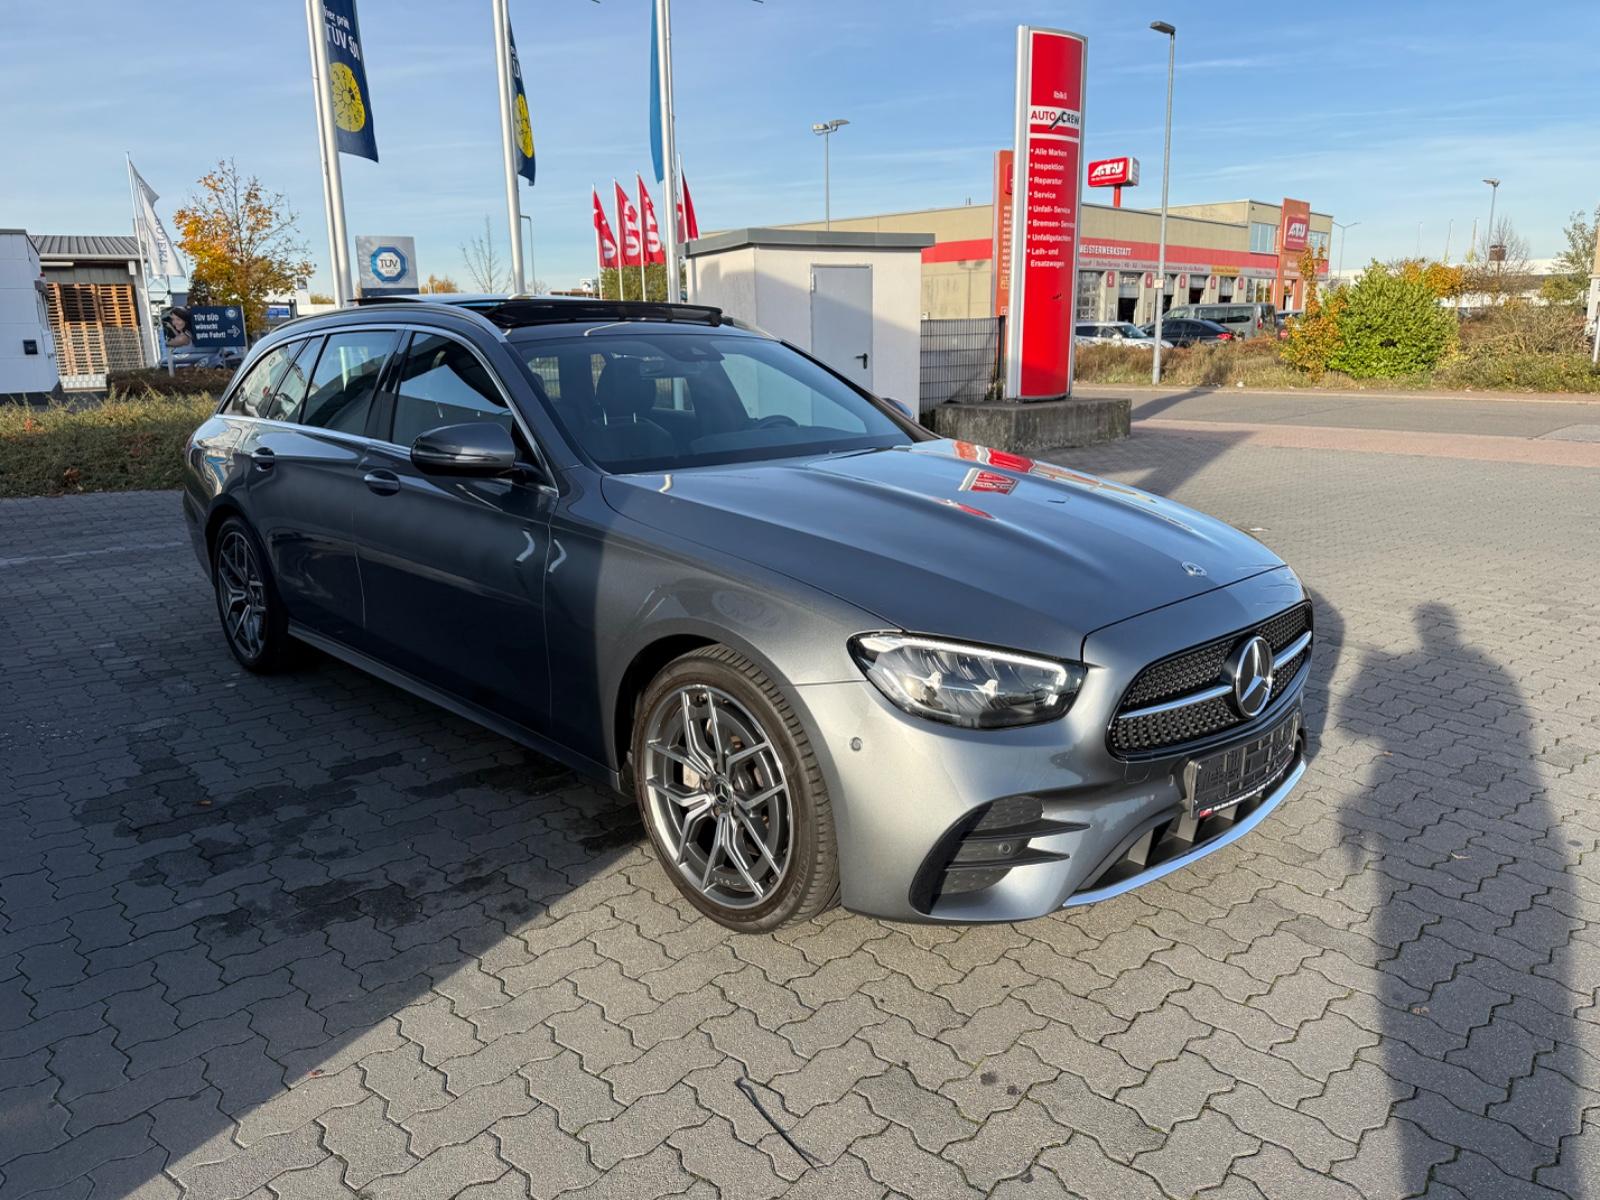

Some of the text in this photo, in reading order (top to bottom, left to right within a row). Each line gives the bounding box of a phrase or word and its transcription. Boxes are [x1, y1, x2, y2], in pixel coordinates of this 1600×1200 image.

[1048, 149, 1067, 157] Marken
[1034, 162, 1064, 171] Inspektion
[1033, 176, 1063, 185] Reparatur
[1033, 191, 1056, 199] Service
[1030, 260, 1065, 269] Ersatzwagen
[193, 313, 220, 321] TÜV SÜD
[196, 332, 209, 340] gute
